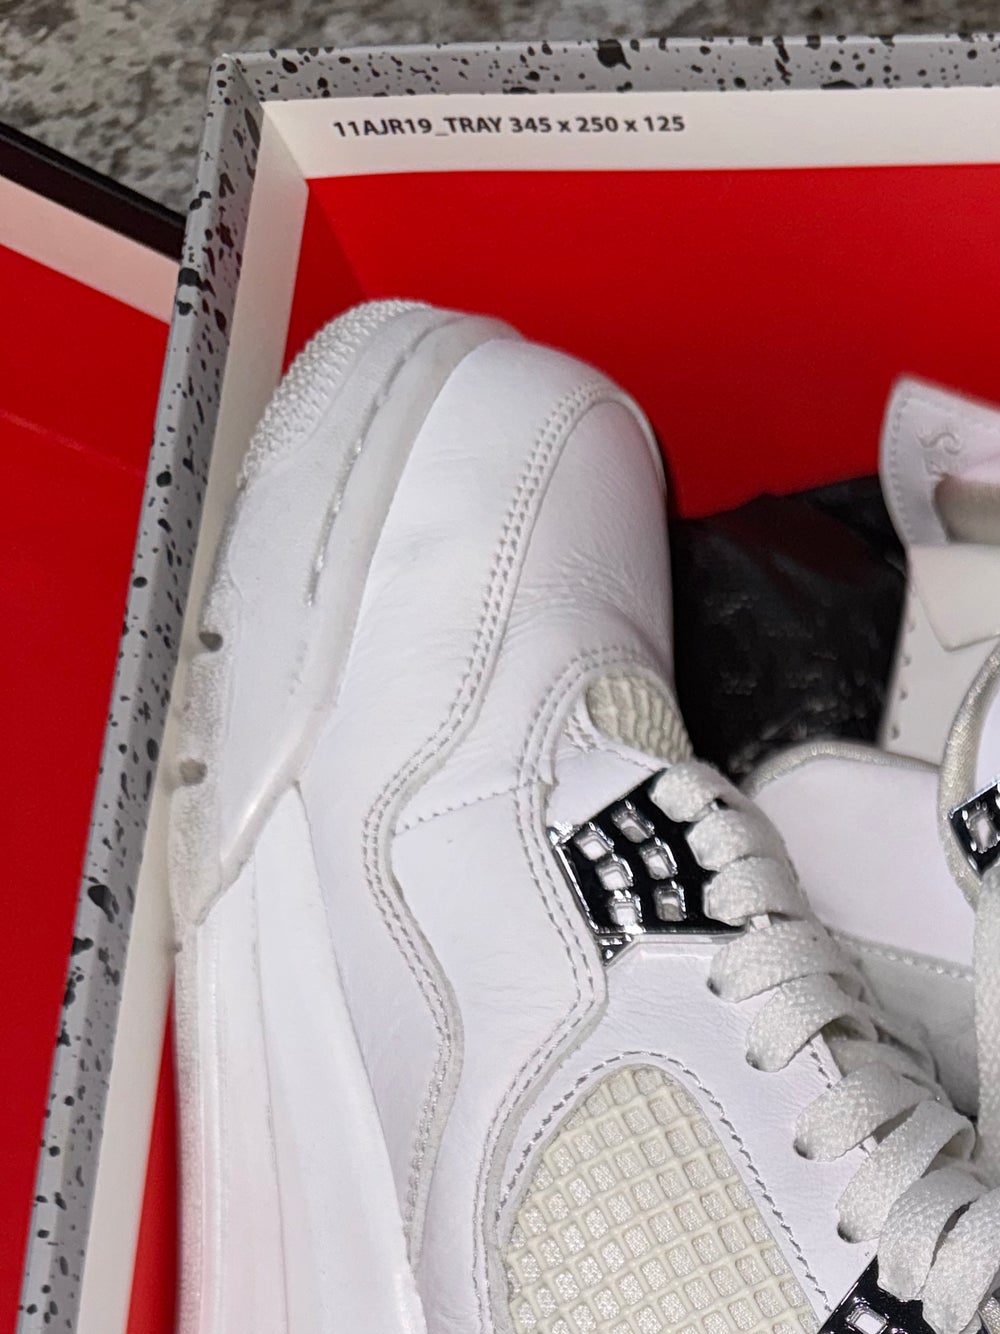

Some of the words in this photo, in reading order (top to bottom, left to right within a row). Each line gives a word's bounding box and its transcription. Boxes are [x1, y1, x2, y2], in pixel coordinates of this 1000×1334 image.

[333, 116, 503, 138] 11AJR19_TRAY
[509, 115, 553, 134] 345
[557, 119, 572, 133] x
[576, 115, 620, 133] 250
[624, 119, 639, 133] x
[643, 115, 686, 133] 125
